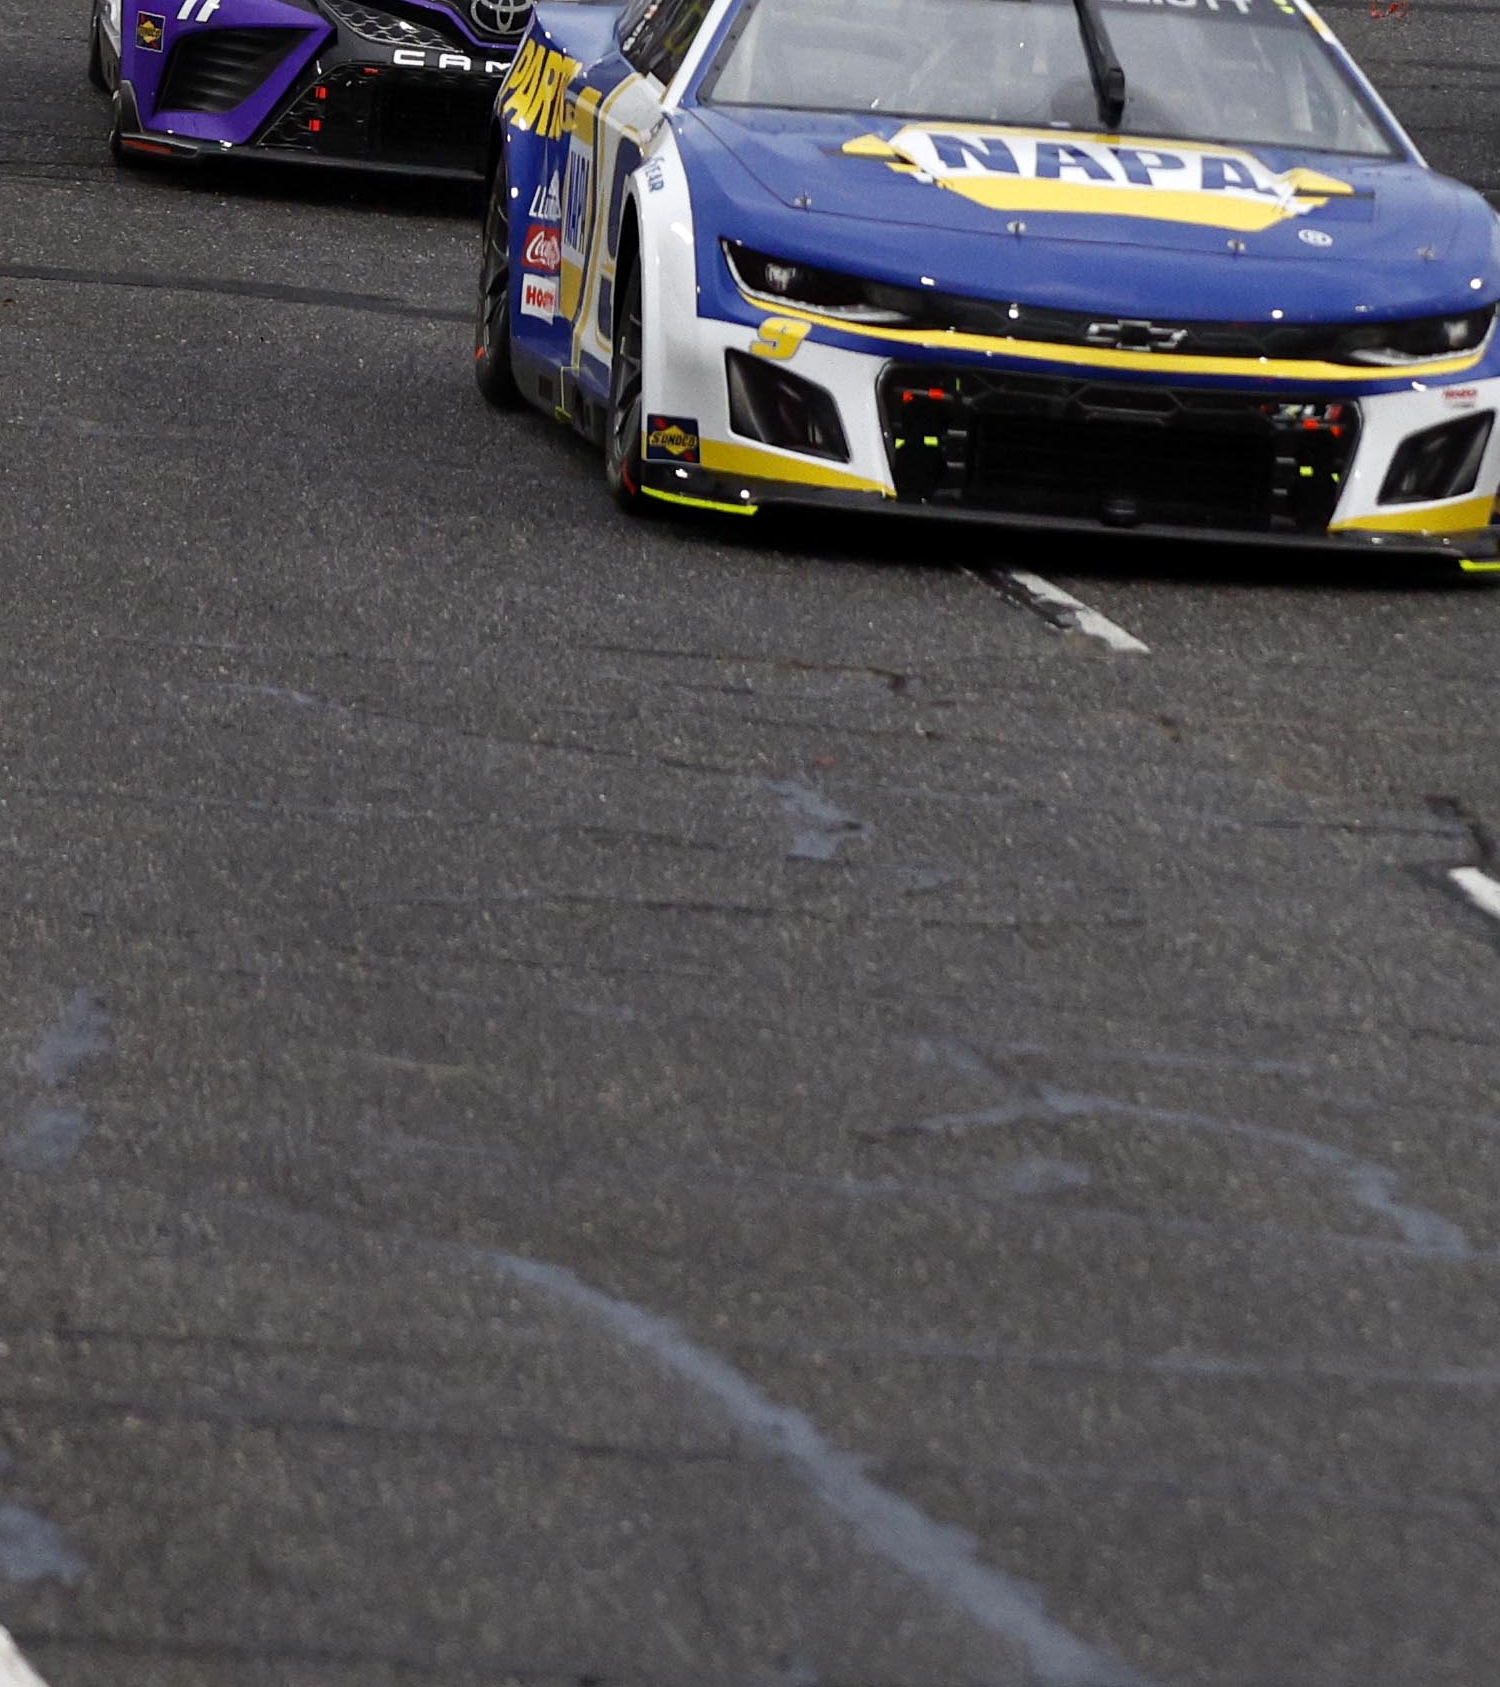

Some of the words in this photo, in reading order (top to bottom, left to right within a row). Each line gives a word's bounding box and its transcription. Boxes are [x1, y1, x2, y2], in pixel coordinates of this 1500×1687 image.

[392, 46, 511, 75] CAM
[928, 134, 1277, 196] NAPA
[749, 316, 813, 360] 9
[651, 431, 696, 448] SUNOCO
